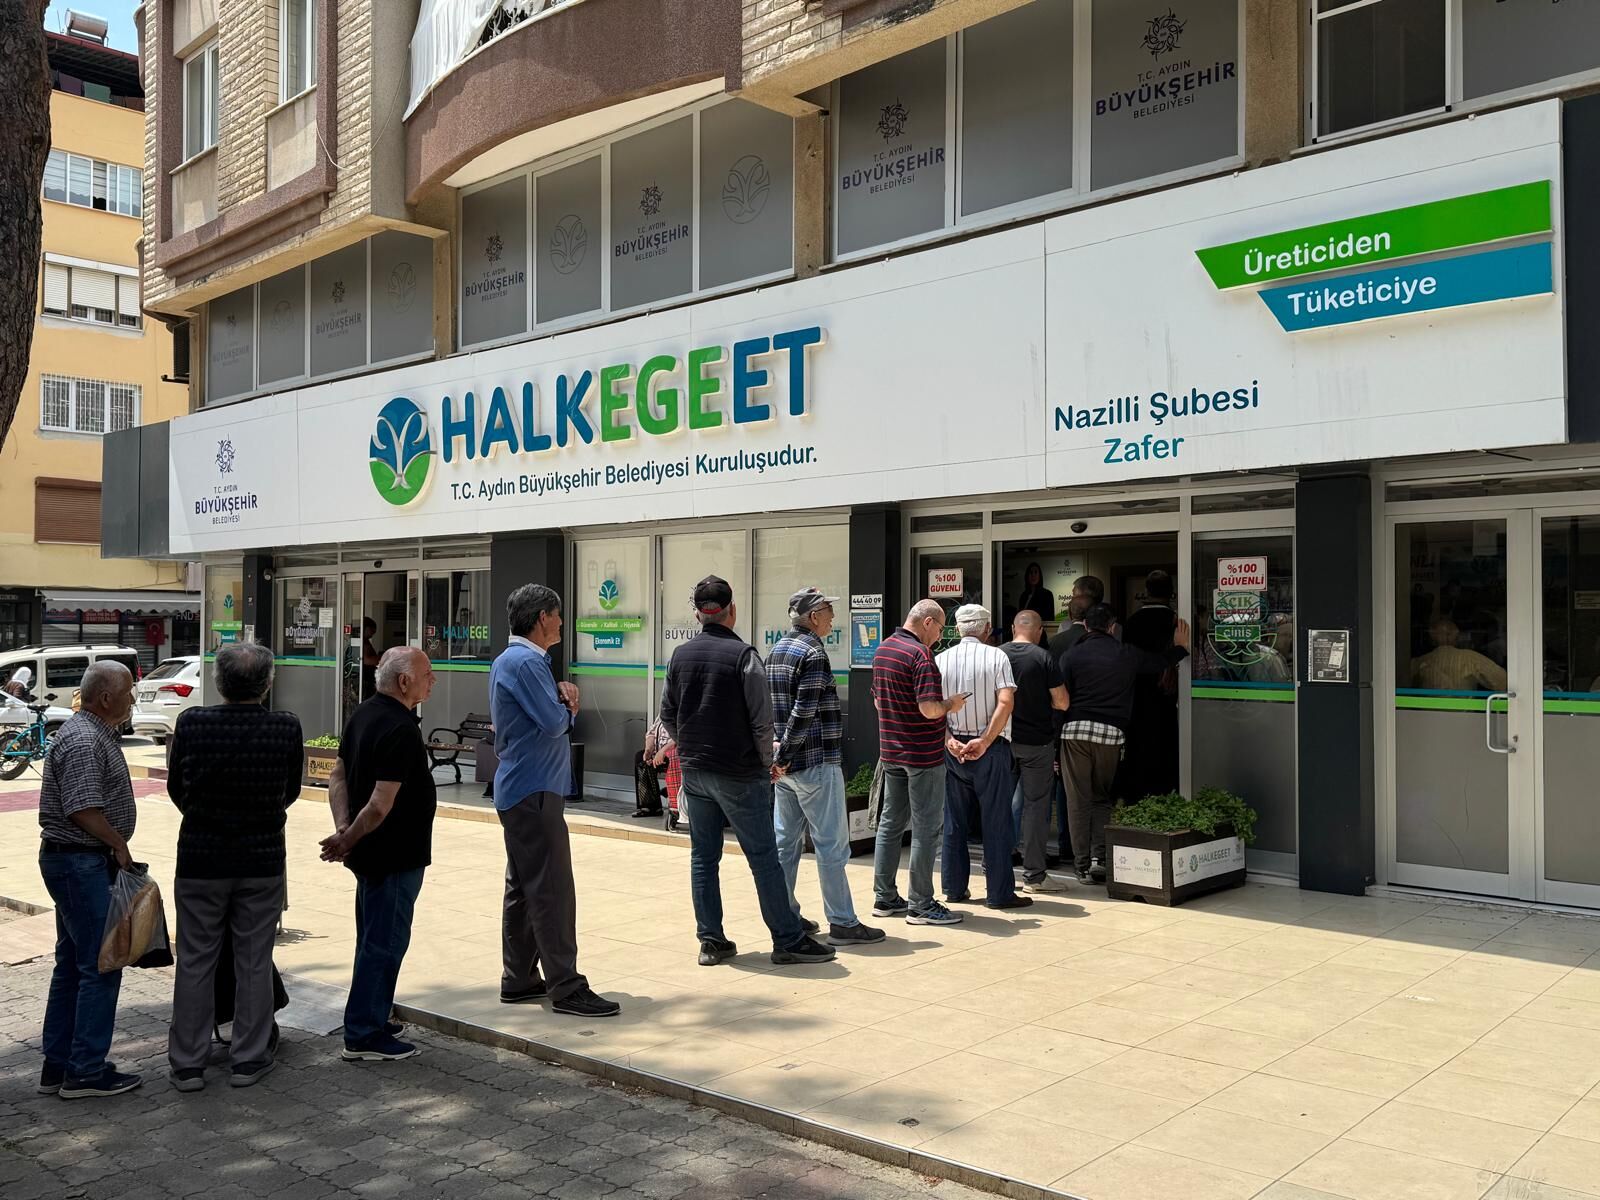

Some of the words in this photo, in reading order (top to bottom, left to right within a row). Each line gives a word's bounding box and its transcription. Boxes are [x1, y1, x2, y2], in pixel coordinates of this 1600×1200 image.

[1137, 71, 1156, 83] T.C.
[1159, 59, 1191, 76] AYDIN
[1095, 61, 1236, 117] BÜYÜKŞEHİR
[1133, 94, 1195, 119] BELEDİYESİ
[889, 144, 913, 159] AYDIN
[842, 146, 945, 191] BÜYÜKŞEHİR
[870, 175, 915, 194] BELEDİYESİ
[649, 221, 666, 232] AYDIN
[614, 224, 689, 258] BÜYÜKŞEHİR
[1244, 230, 1392, 276] Üreticiden
[464, 271, 525, 298] BÜYÜKŞEHİR
[1287, 274, 1438, 317] Tüketiciye
[442, 326, 824, 464] HALKEGEET
[1054, 395, 1141, 432] Nazilli
[1149, 379, 1260, 427] Şubesi
[1103, 434, 1185, 466] Zafer
[451, 483, 475, 501] T.C.
[478, 476, 515, 500] Aydın
[519, 471, 601, 497] Büyükşehir
[605, 455, 690, 486] Belediyesi
[696, 443, 818, 475] Kuruluşudur.
[195, 491, 258, 516] BÜYÜKŞEHİR
[934, 573, 956, 582] %100
[1220, 574, 1265, 586] GÜVENLİ
[1227, 563, 1257, 574] %100
[930, 583, 961, 593] GÜVENLİ
